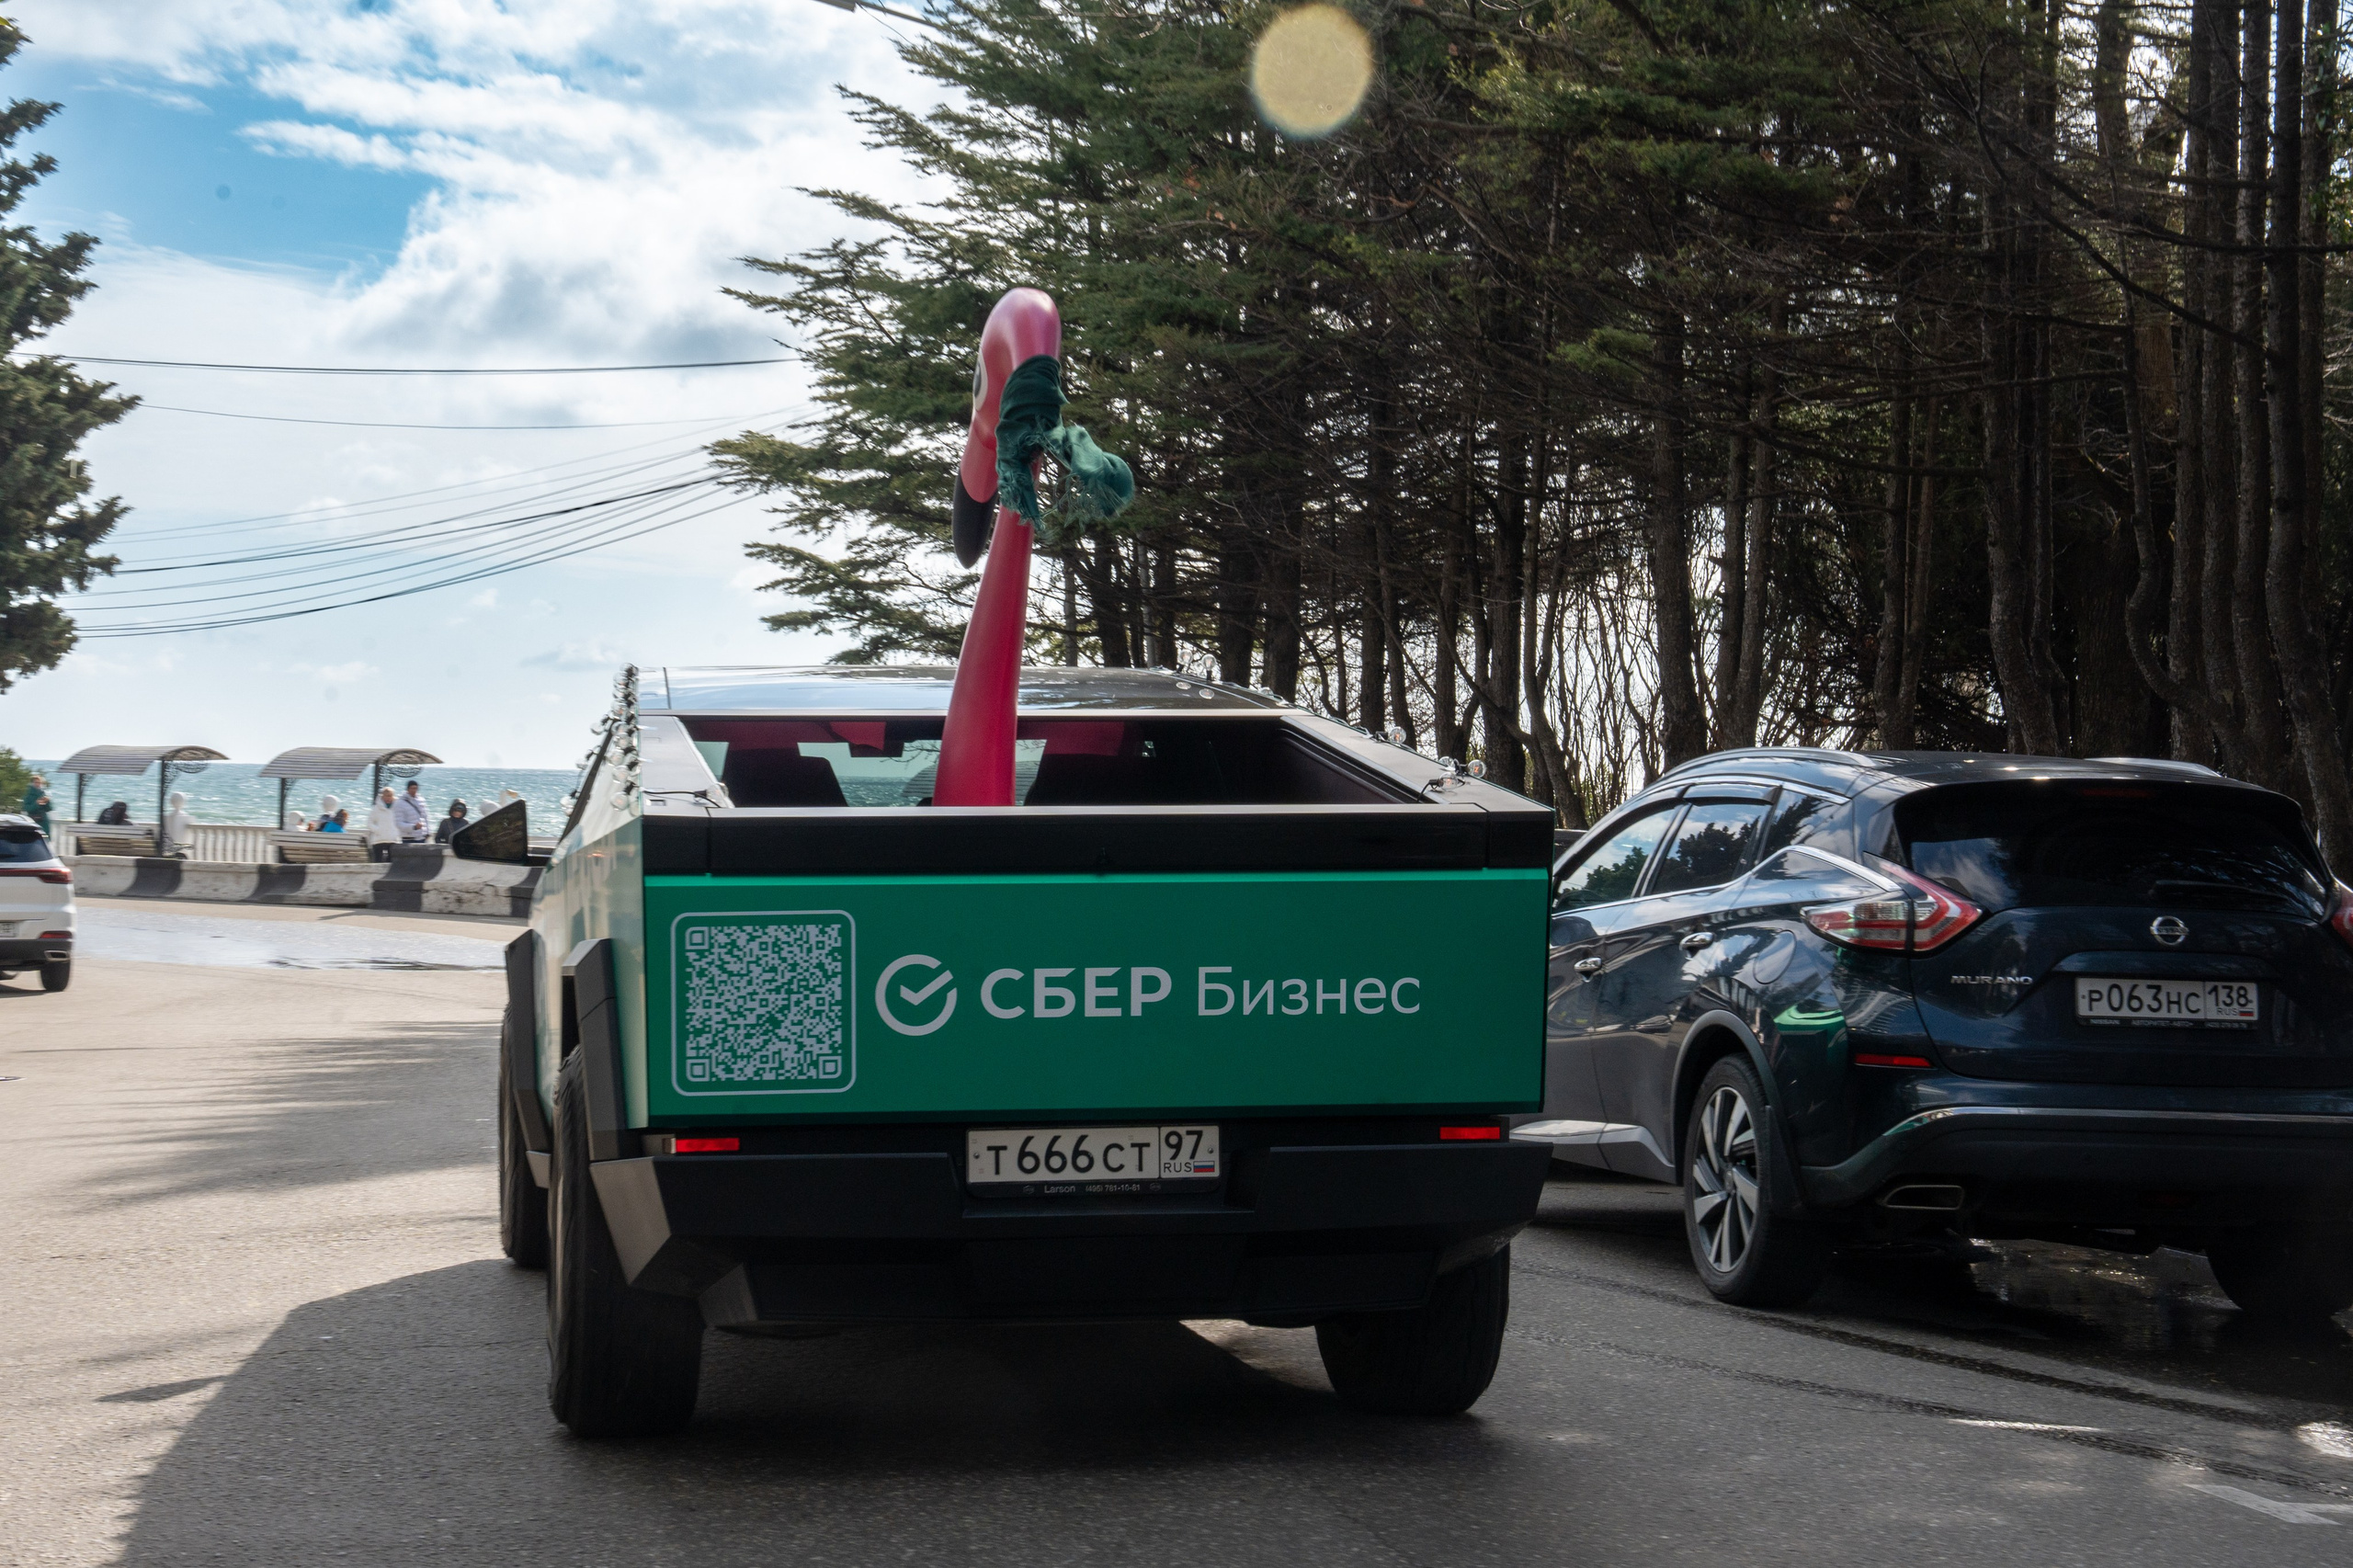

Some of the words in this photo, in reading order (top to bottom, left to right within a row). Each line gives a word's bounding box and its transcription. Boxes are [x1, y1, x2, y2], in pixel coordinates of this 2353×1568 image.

[1950, 975, 2033, 985] MURANO
[981, 967, 1172, 1018] СБЕР
[1196, 965, 1421, 1017] Бизнес
[2088, 983, 2200, 1014] Р063НС
[2208, 984, 2248, 1007] 138
[2216, 1008, 2239, 1017] RUS
[986, 1134, 1151, 1176] Т666СТ
[1164, 1131, 1204, 1161] 97
[1163, 1162, 1193, 1174] RUS
[1044, 1185, 1076, 1194] Larson
